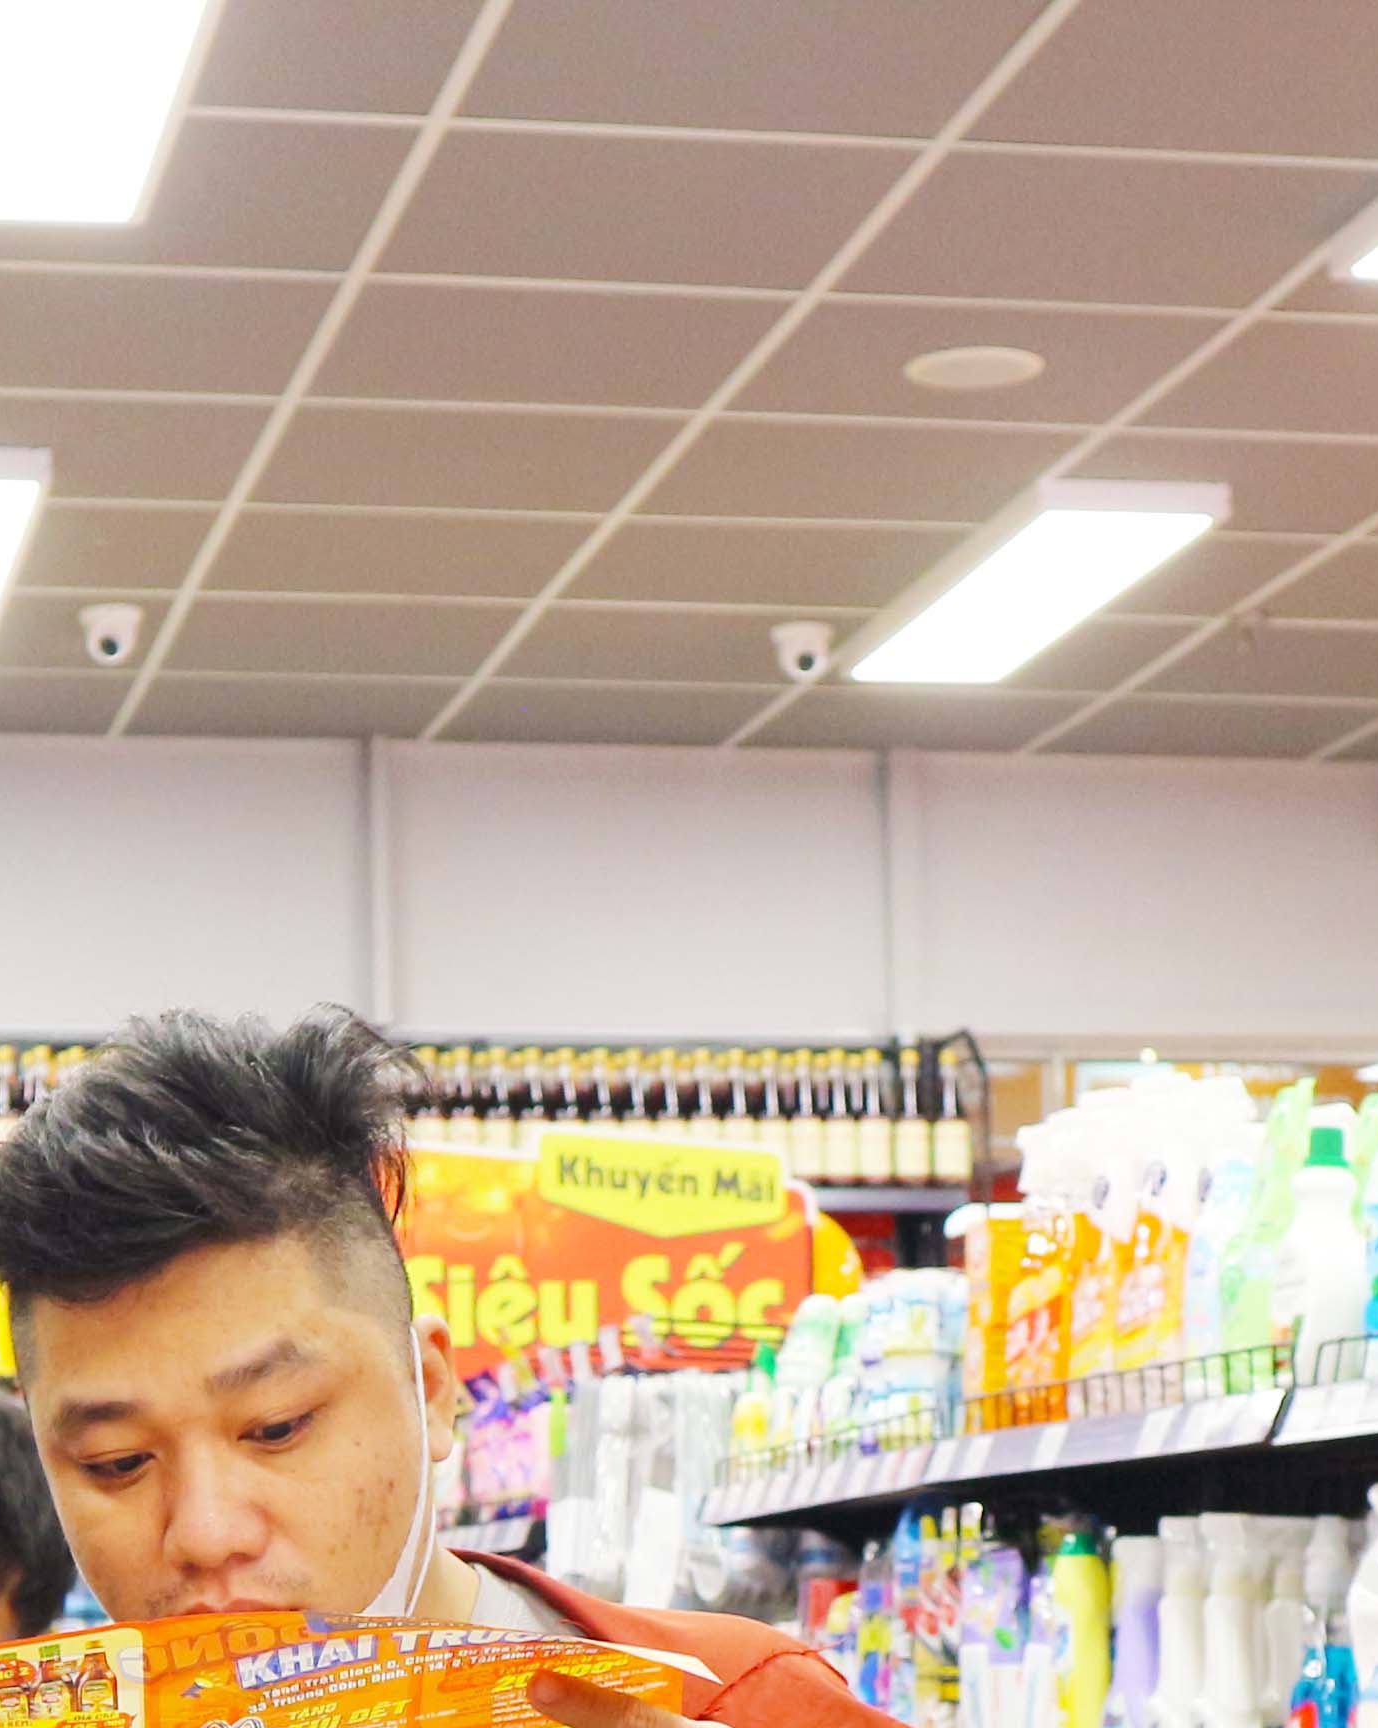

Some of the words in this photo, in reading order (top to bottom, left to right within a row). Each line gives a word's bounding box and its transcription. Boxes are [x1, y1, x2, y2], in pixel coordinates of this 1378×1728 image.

[621, 1242, 785, 1349] Sốc
[236, 1634, 375, 1689] KHAI
[339, 1664, 381, 1679] Block
